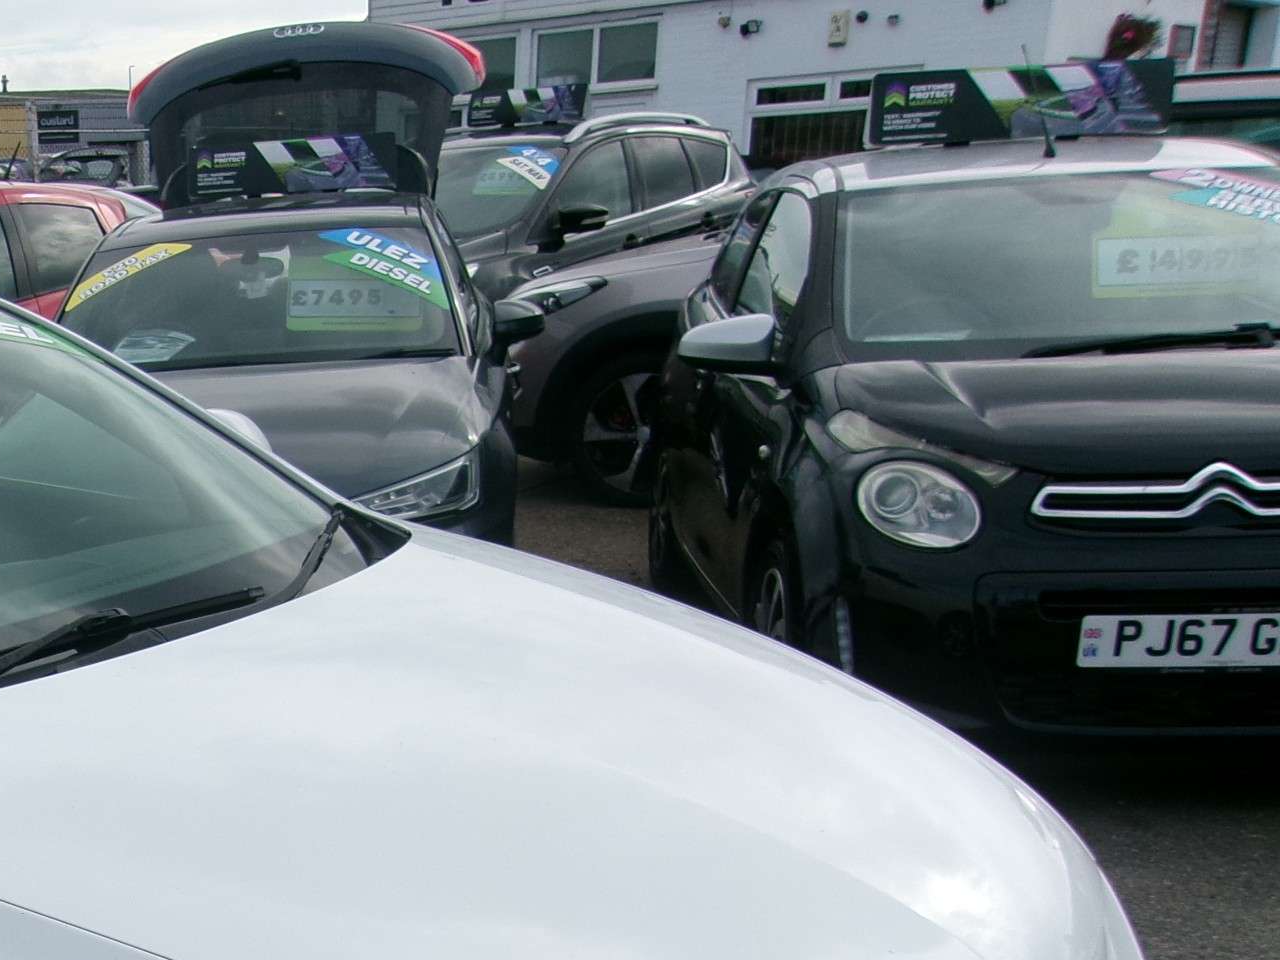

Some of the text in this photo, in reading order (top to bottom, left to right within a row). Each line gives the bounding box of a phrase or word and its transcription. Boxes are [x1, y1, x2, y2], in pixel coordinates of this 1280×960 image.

[346, 231, 429, 269] ULEZ
[349, 252, 432, 295] DIESEL
[292, 288, 382, 306] £7495
[1113, 618, 1239, 657] PJ67
